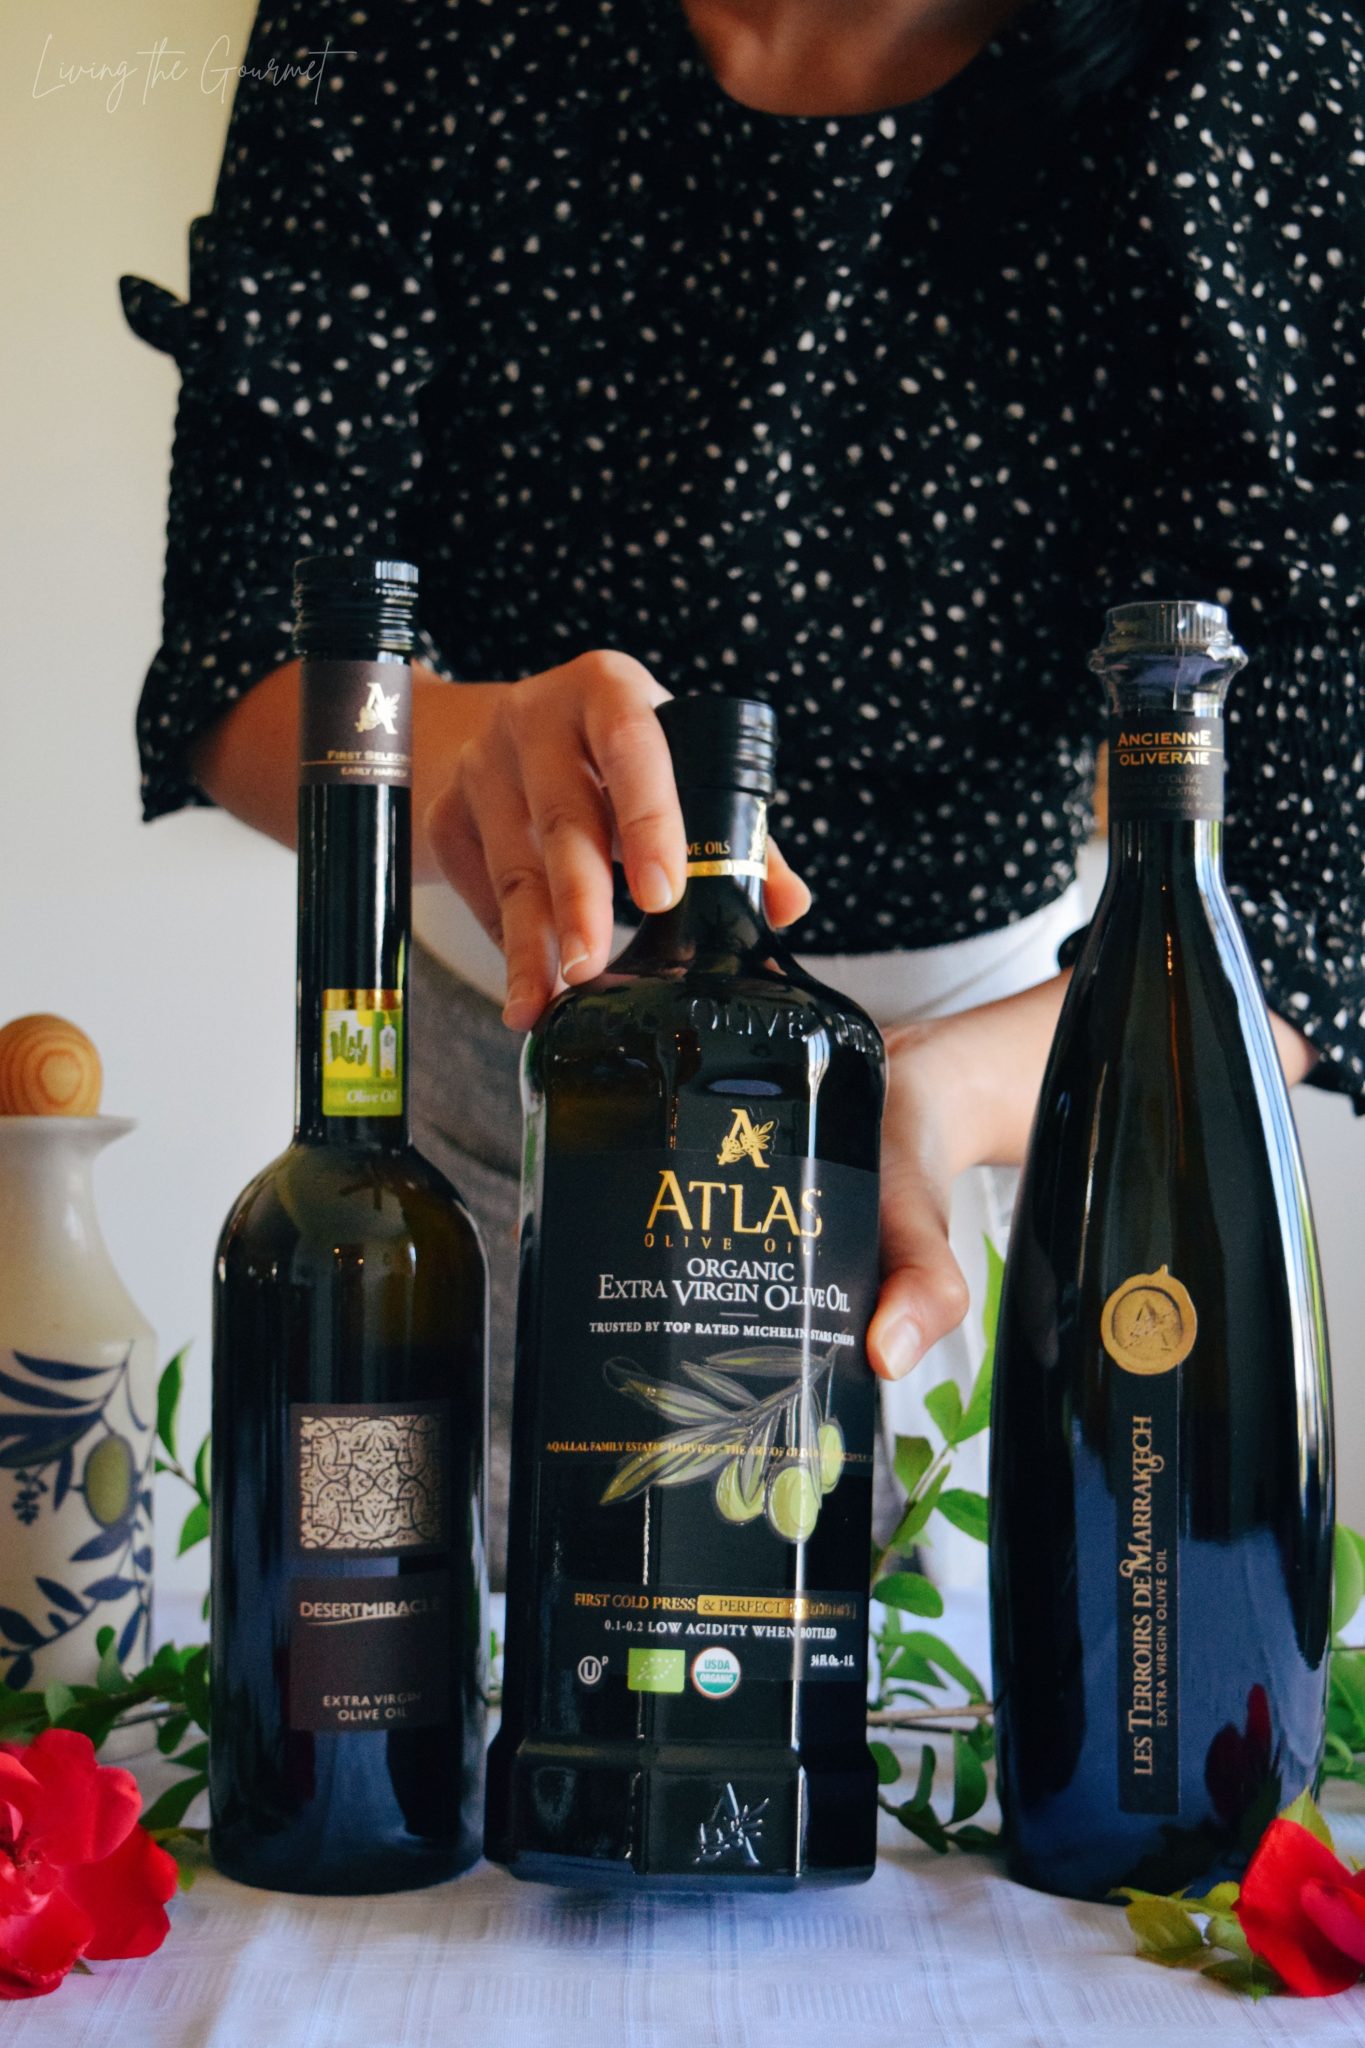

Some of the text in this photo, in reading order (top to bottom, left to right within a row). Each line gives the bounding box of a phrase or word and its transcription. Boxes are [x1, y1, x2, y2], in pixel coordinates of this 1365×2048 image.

[1118, 729, 1212, 747] ANCIENNE
[1119, 751, 1210, 766] OLIVERAIE
[704, 840, 731, 855] OILS
[646, 1169, 823, 1238] ATLAS
[644, 1232, 732, 1251] OLIVE
[687, 1257, 795, 1282] ORGANIC
[598, 1273, 850, 1313] EXTRA VIRGIN OLIVE OIL
[589, 1321, 642, 1333] TRUSTED
[645, 1321, 659, 1332] BY
[663, 1321, 691, 1334] TOP
[695, 1322, 740, 1336] RATED
[743, 1324, 809, 1339] MICHELIN
[810, 1329, 832, 1344] STARS
[546, 1440, 590, 1453] AQALLAL
[590, 1441, 625, 1452] FAMILY
[574, 1592, 610, 1607] FIRST
[612, 1594, 650, 1609] COLD
[652, 1596, 696, 1611] PRESS
[702, 1600, 714, 1612] &
[719, 1599, 782, 1614] PERFECT
[1119, 1415, 1165, 1776] LES TERROIRS DE MARRAKECH
[604, 1619, 837, 1640] 0.1-0.2 LOW ACIDITY WHEN BOTTLED
[1156, 1548, 1168, 1727] EXTRA VIRGIN OLIVE OIL
[704, 1659, 731, 1670] USDA
[323, 1695, 371, 1708] EXTRA
[337, 1708, 380, 1721] OLIVE
